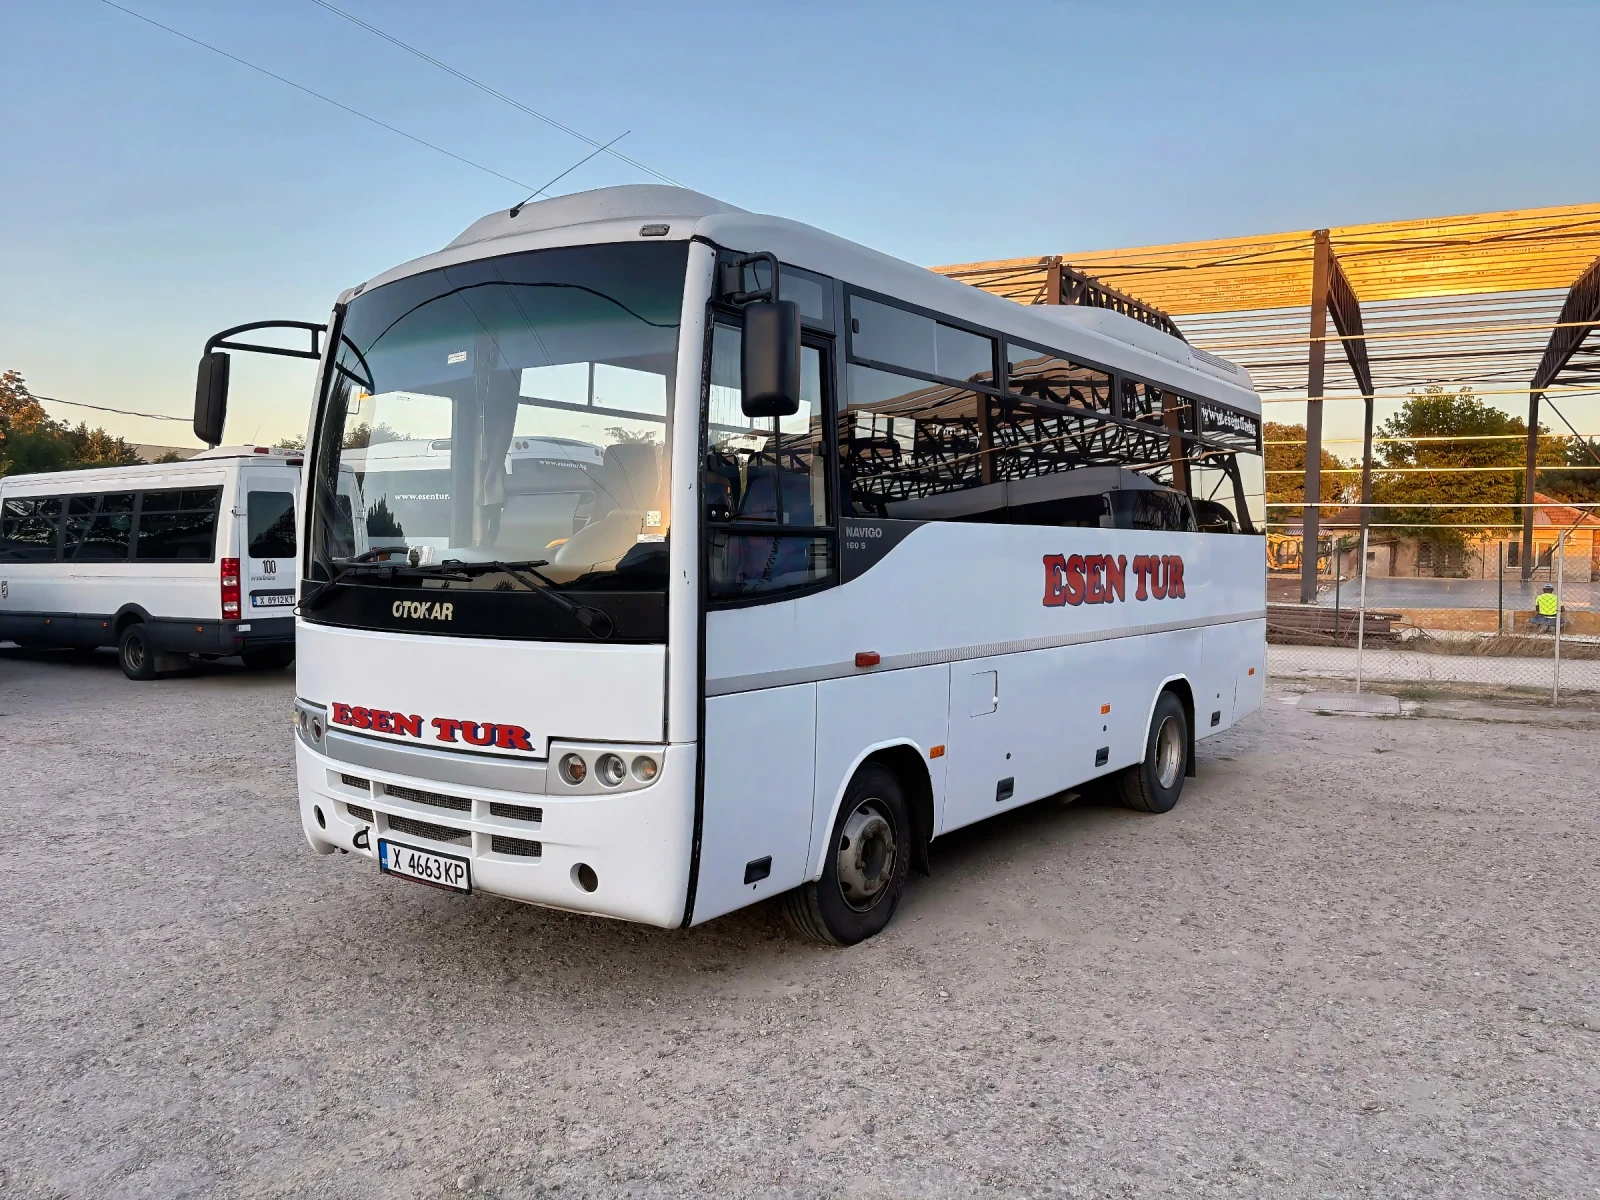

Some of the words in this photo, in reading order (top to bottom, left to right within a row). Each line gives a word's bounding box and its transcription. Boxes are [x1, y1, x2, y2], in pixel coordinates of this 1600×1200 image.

[539, 459, 587, 471] www.esentur.bg
[845, 526, 883, 538] NAVIGO
[846, 541, 859, 549] 160
[262, 560, 277, 574] 100
[1043, 553, 1128, 607] ESEN
[1133, 554, 1186, 601] TUR
[260, 597, 265, 605] X
[392, 600, 454, 621] OTOKAR
[331, 702, 425, 738] ESEN
[431, 717, 536, 751] TUR
[393, 847, 402, 870] X
